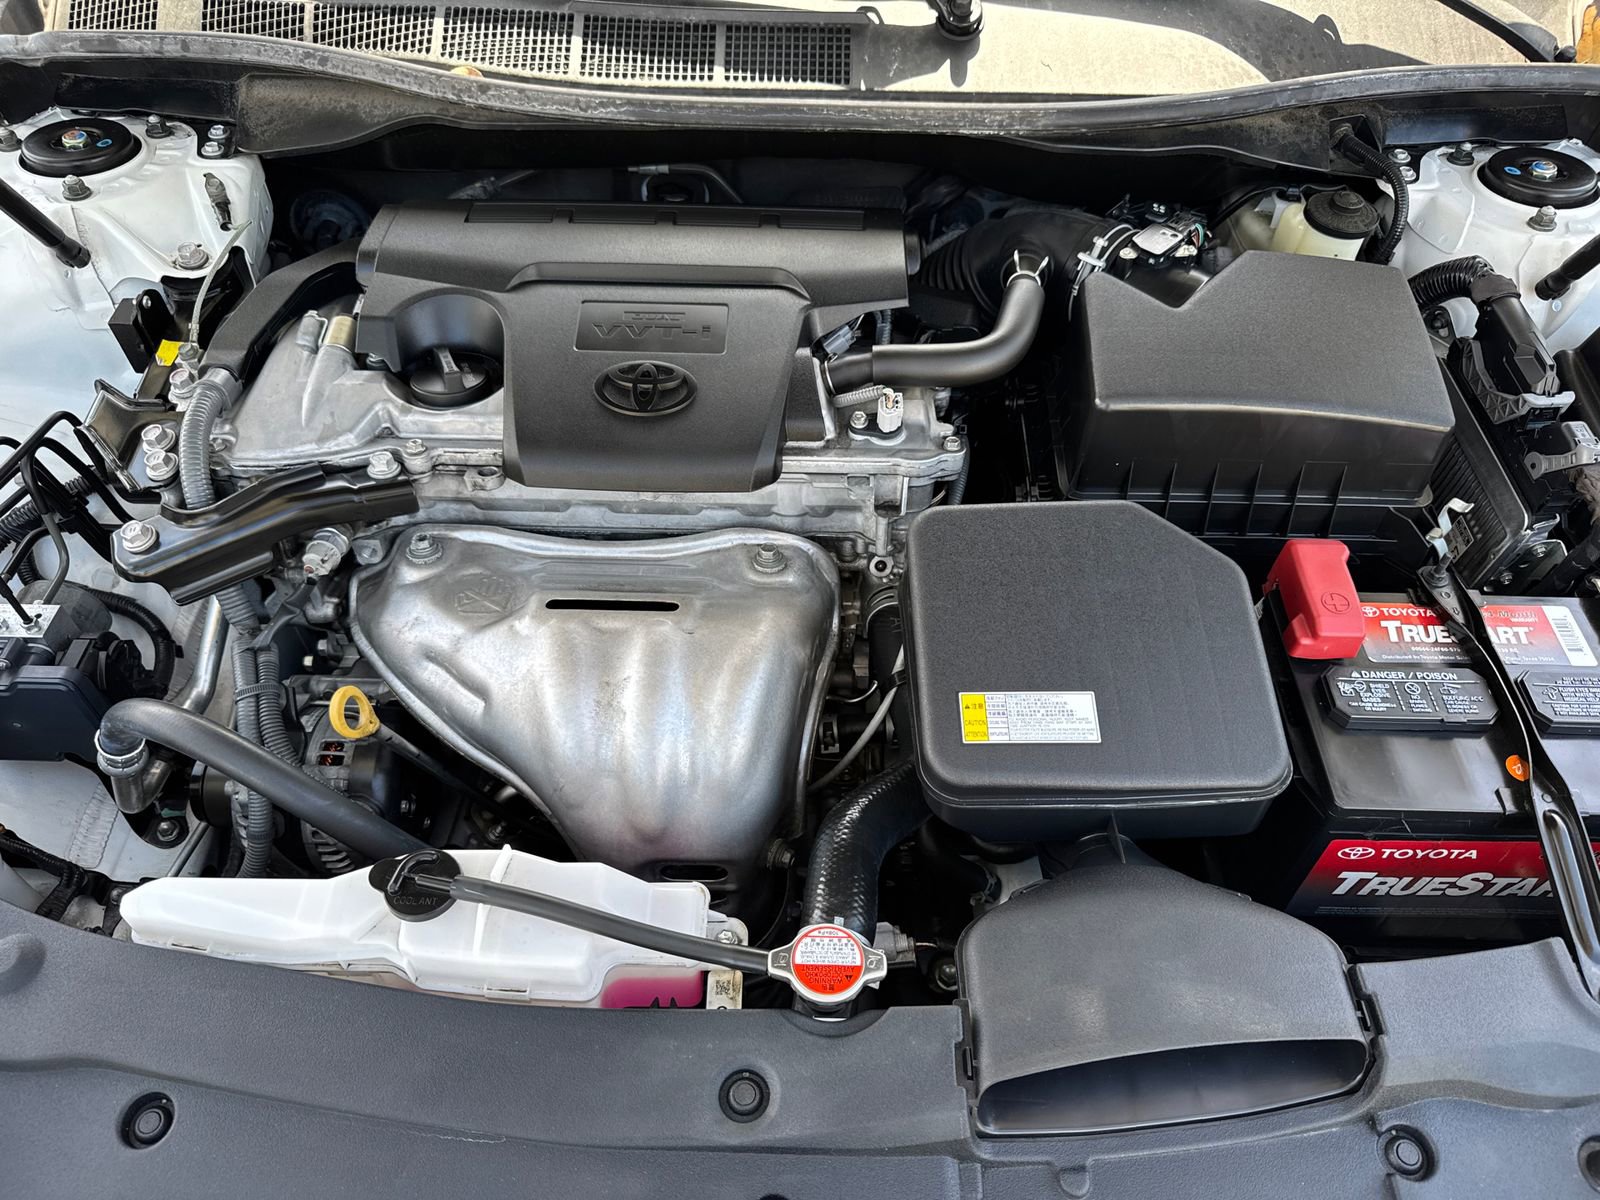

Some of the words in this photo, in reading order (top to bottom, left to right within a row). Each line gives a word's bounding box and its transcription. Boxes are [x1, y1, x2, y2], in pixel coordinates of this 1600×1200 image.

[1380, 608, 1437, 617] TOYOTA
[1361, 671, 1406, 679] DANGER
[1417, 672, 1458, 680] POISON
[1380, 848, 1477, 860] TOYOTA
[393, 896, 438, 905] COOLANT
[801, 965, 855, 973] AVERTISSEMENT
[808, 977, 843, 985] WARNING
